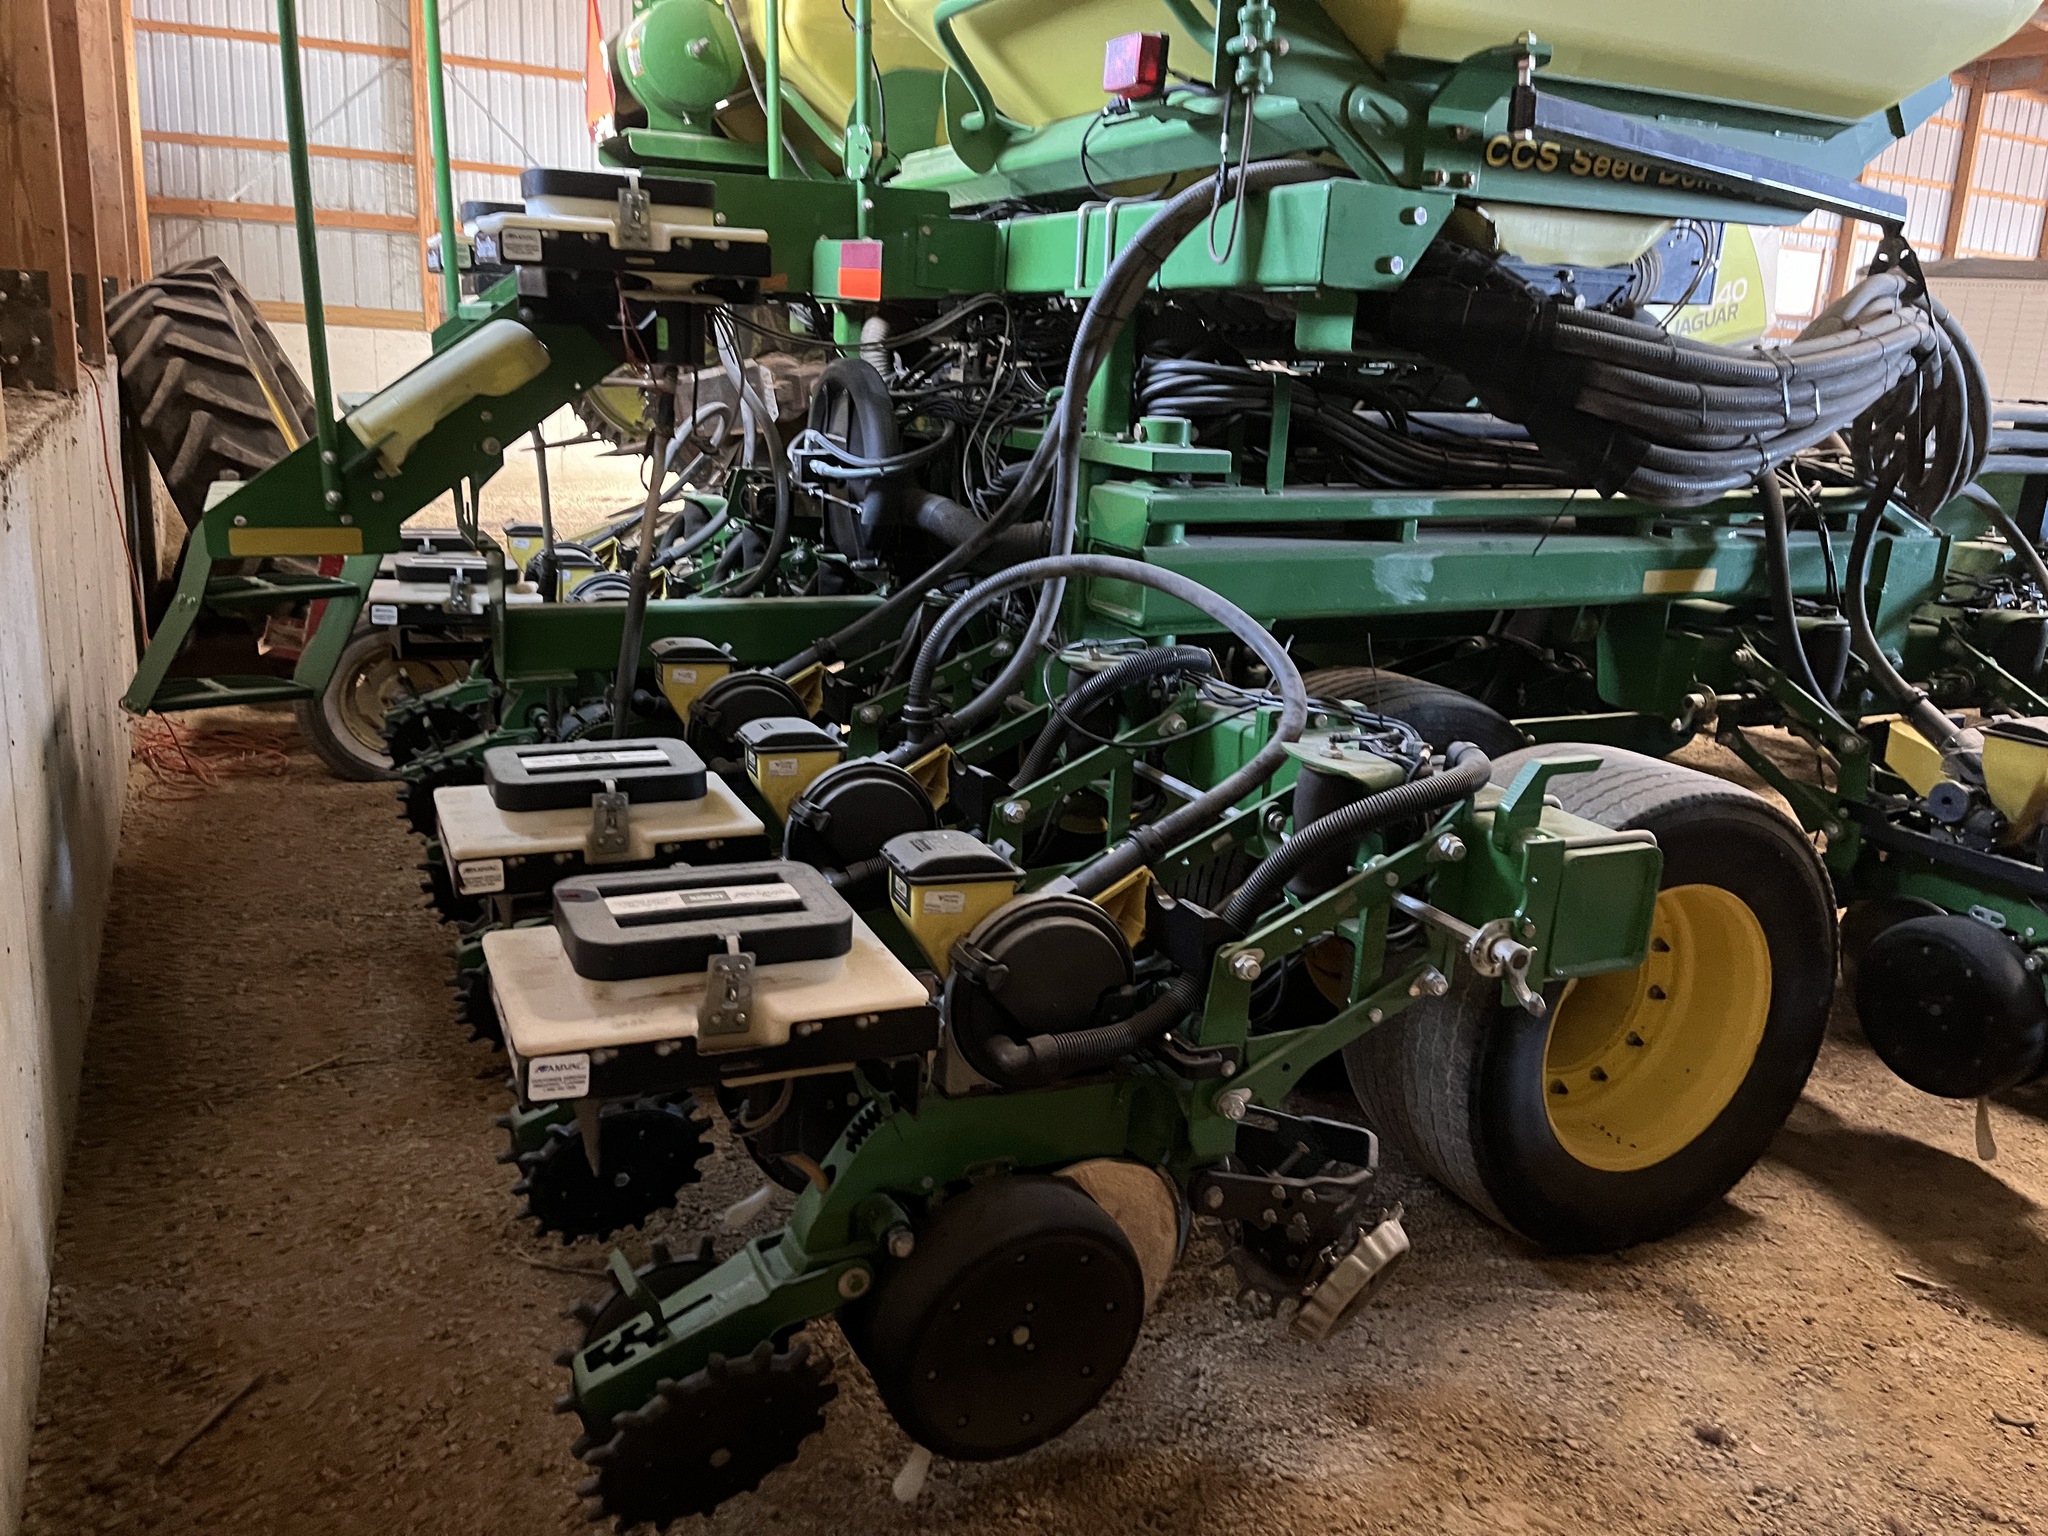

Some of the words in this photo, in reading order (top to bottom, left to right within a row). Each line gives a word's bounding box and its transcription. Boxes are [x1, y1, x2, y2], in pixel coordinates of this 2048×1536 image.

[1486, 134, 1561, 172] CCS
[1570, 148, 1649, 183] Seed
[1674, 303, 1739, 335] JAGUAR
